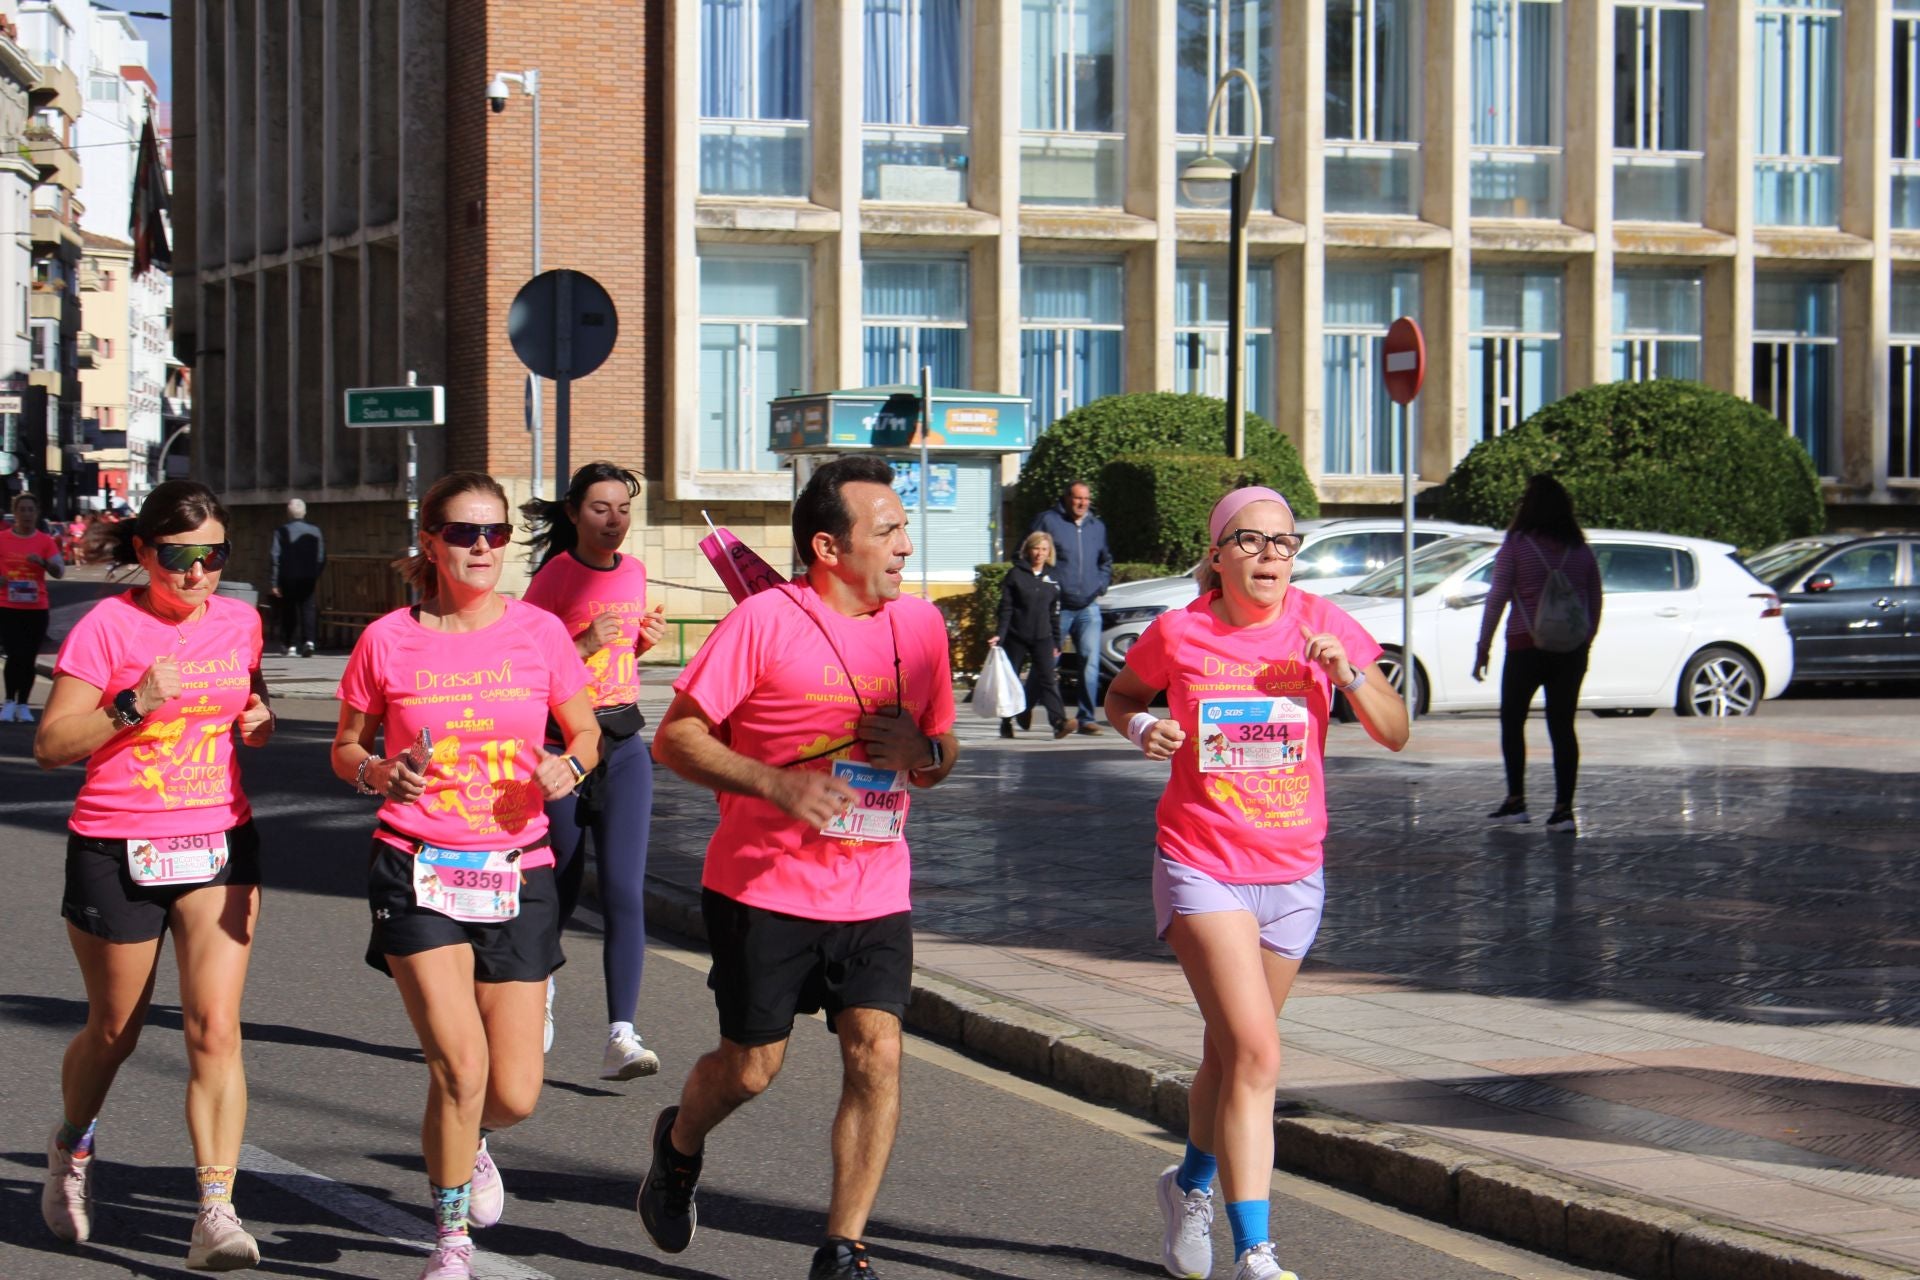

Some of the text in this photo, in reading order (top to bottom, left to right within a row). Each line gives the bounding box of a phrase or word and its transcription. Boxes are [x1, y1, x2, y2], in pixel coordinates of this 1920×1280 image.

[362, 408, 389, 419] Santa
[181, 705, 222, 714] SUZUKI
[445, 718, 495, 730] SUZUKI
[1239, 724, 1290, 741] 3244
[1230, 747, 1244, 766] 11
[186, 779, 226, 797] Mujer
[1243, 775, 1310, 794] Carrera
[1265, 790, 1310, 809] Mujer
[850, 813, 865, 833] 11
[1254, 818, 1312, 829] DRASANVI
[168, 833, 212, 851] 3361
[159, 858, 174, 877] 11
[453, 869, 503, 889] 3359
[442, 892, 457, 912] 11
